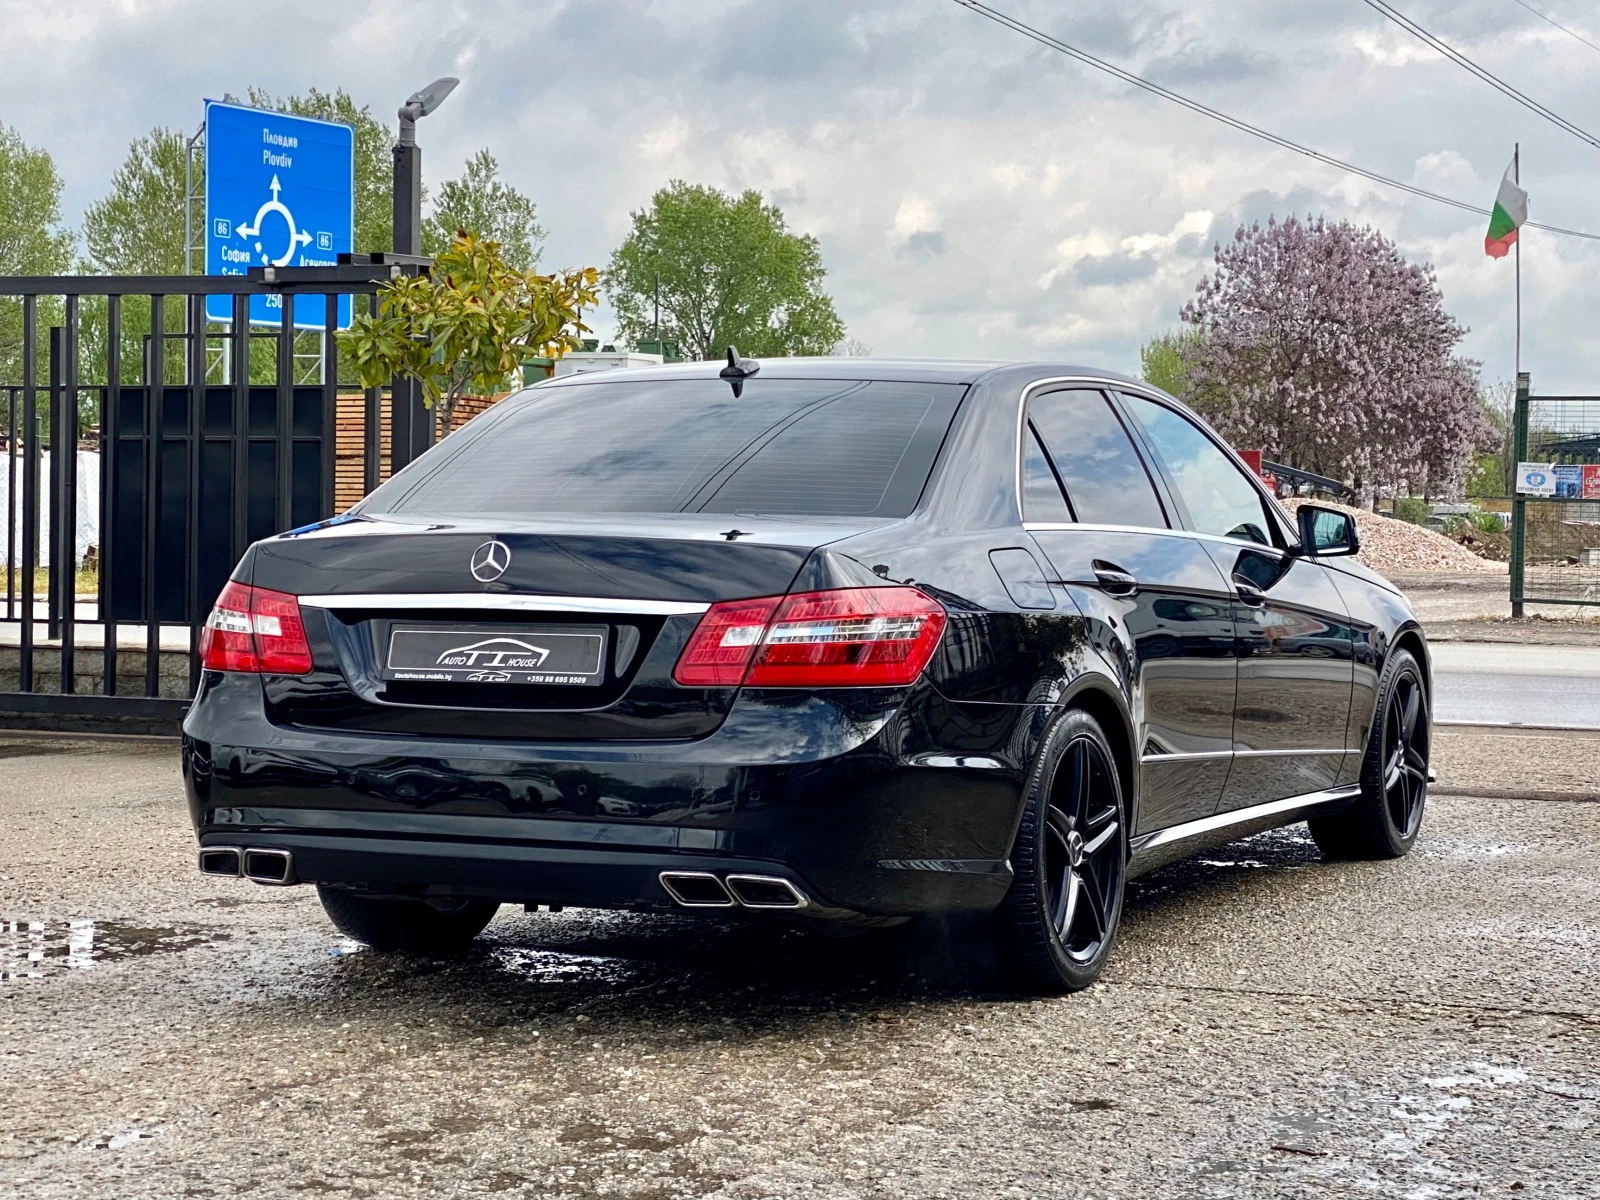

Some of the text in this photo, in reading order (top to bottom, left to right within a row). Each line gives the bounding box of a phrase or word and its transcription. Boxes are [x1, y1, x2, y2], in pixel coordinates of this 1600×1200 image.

[263, 128, 298, 148] Пловдив
[263, 149, 292, 168] Plovdiv
[217, 222, 228, 235] 86
[320, 234, 330, 247] 86
[221, 245, 250, 263] София
[265, 293, 283, 309] 250
[441, 656, 467, 665] AUTO
[506, 658, 538, 667] HOUSE
[527, 675, 544, 683] +359
[569, 676, 587, 684] 9509
